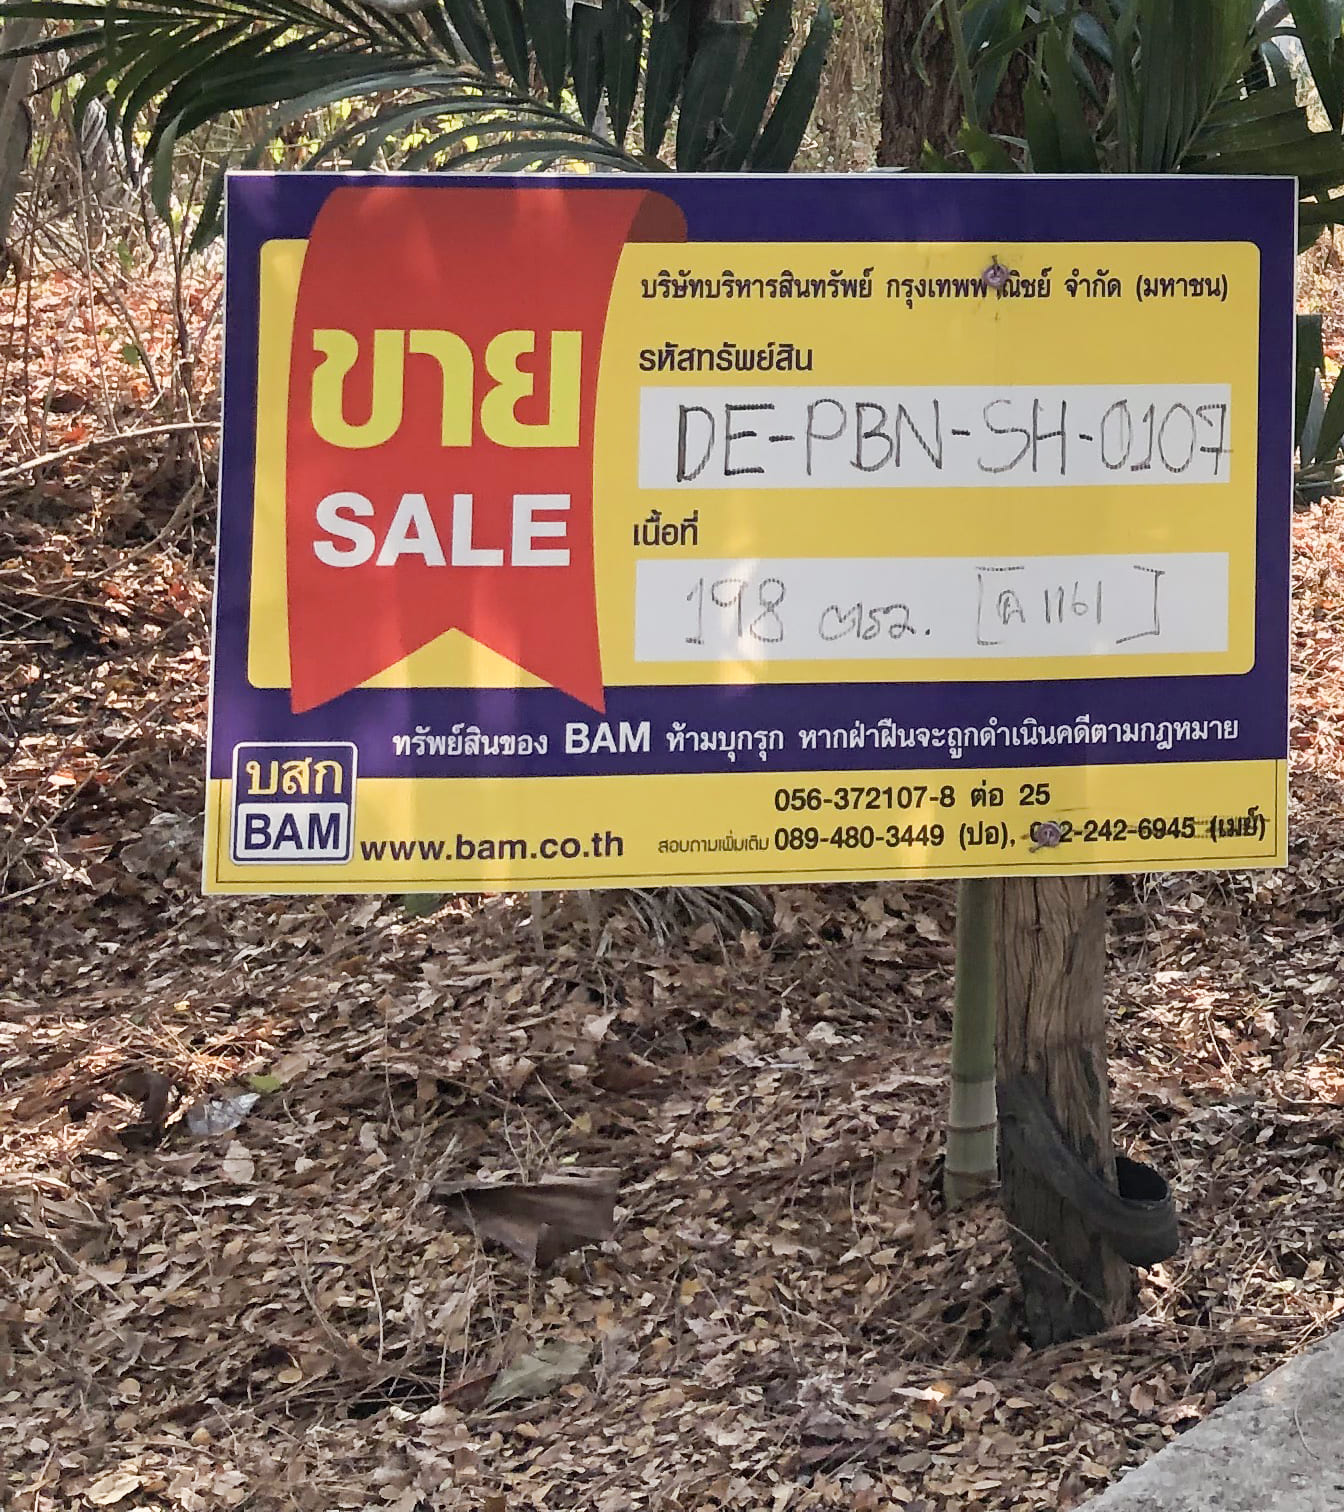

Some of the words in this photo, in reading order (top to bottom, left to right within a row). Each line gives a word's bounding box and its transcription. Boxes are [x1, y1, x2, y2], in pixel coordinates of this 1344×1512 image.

[640, 266, 874, 299] บริษัทบริหารสินทรัพย์
[886, 266, 1052, 309] กรุงเทพพณิชย์
[1064, 268, 1122, 299] จำกัด
[1135, 274, 1229, 302] (มหาชน)
[638, 341, 814, 372] รหัสทรัพย์สิน
[311, 328, 582, 449] ขาย
[313, 491, 571, 568] SALE
[633, 509, 699, 546] เนื้อที่
[686, 576, 786, 645] 198
[392, 722, 548, 756] ทรัพย์สินของ
[565, 721, 650, 754] BAM
[665, 721, 785, 763] ห้ามบุกรุก
[798, 716, 1240, 759] หากฝ่าฝืนจะถูกดำเนินคดีตามกฎหมาย
[246, 756, 343, 796] บสก
[774, 785, 956, 812] 056-372107-8
[970, 779, 1005, 808] ต่อ
[1019, 783, 1051, 806] 25
[243, 812, 341, 851] BAM
[361, 831, 624, 861] www.bam.co.th
[774, 823, 945, 851] 089-480-3449
[1029, 815, 1196, 845] 02-242-6945
